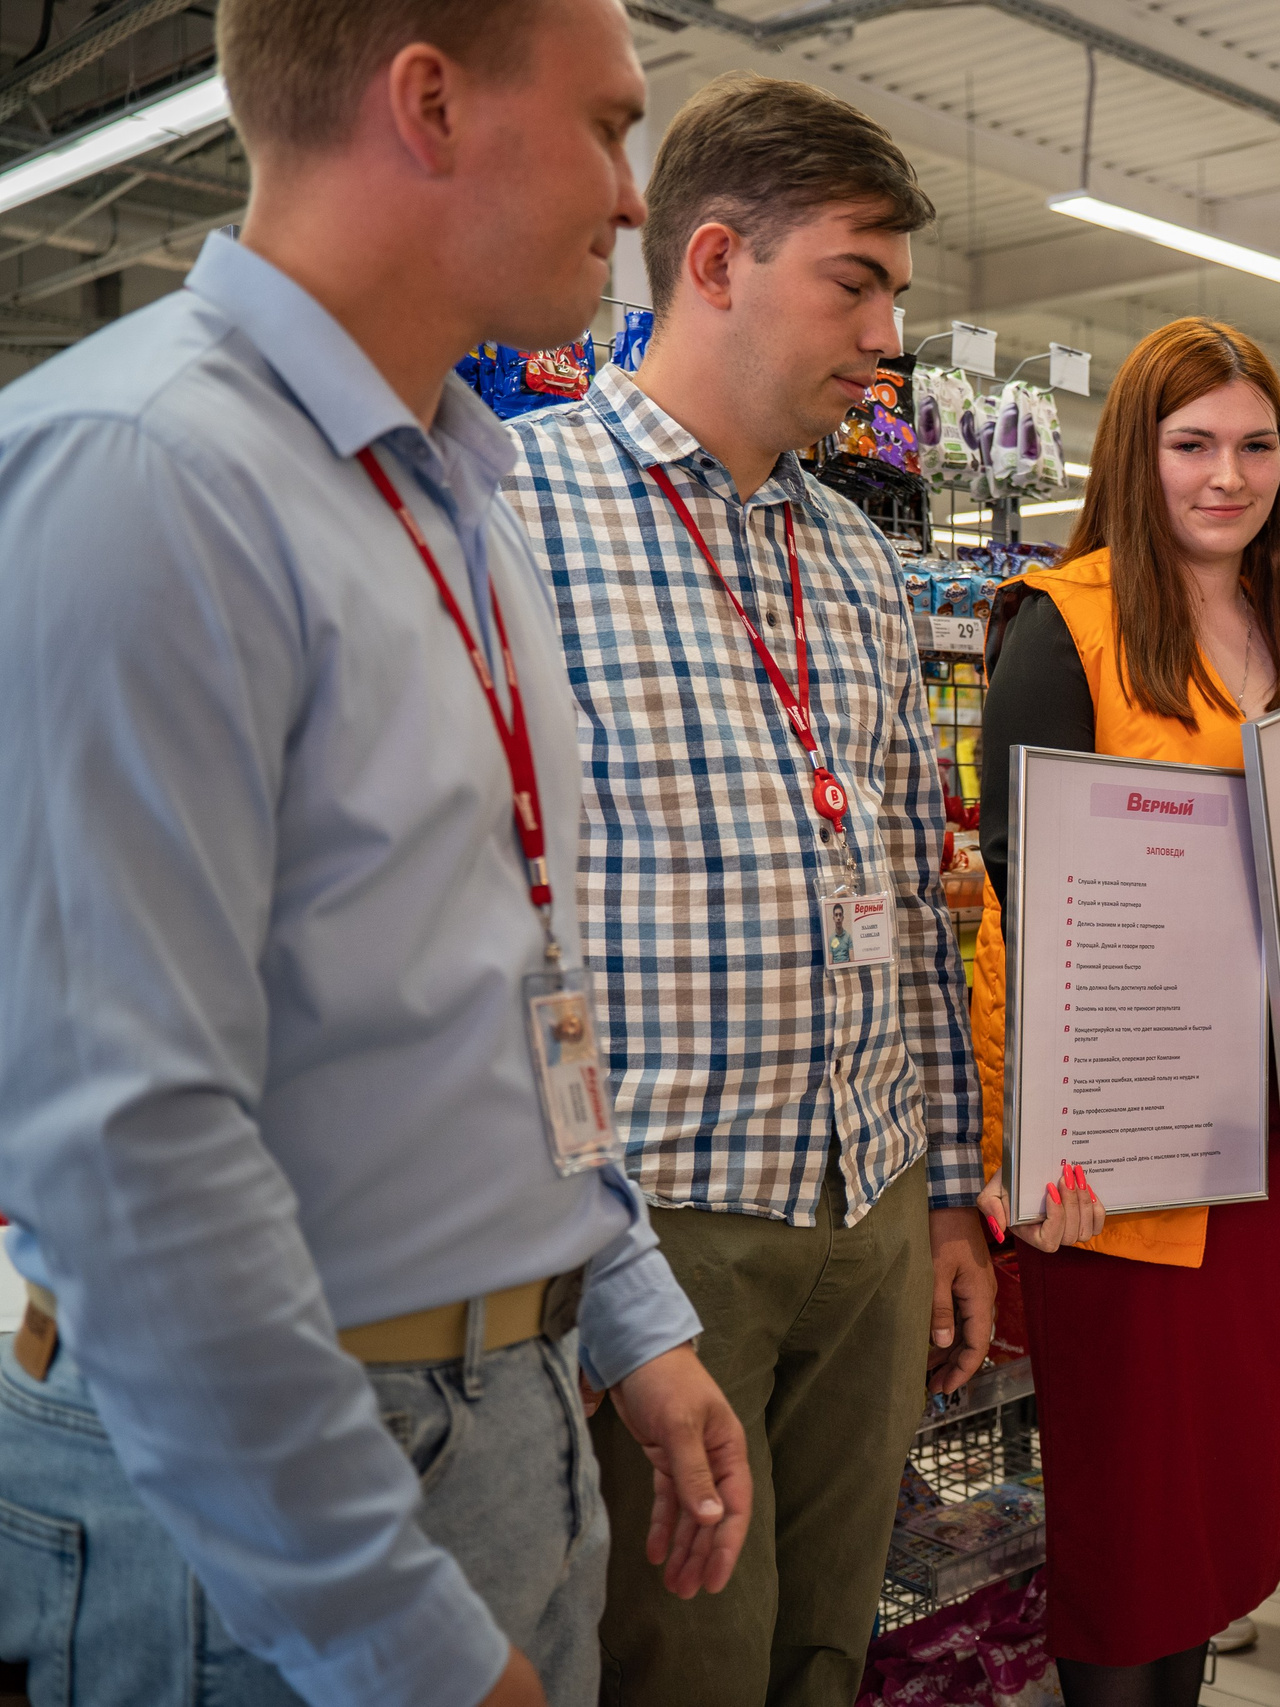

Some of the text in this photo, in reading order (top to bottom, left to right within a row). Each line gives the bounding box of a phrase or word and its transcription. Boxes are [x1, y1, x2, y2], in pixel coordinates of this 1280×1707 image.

[958, 623, 974, 638] 29
[1146, 846, 1184, 858] ЗАПОВЕДИ
[854, 901, 884, 914] Верный
